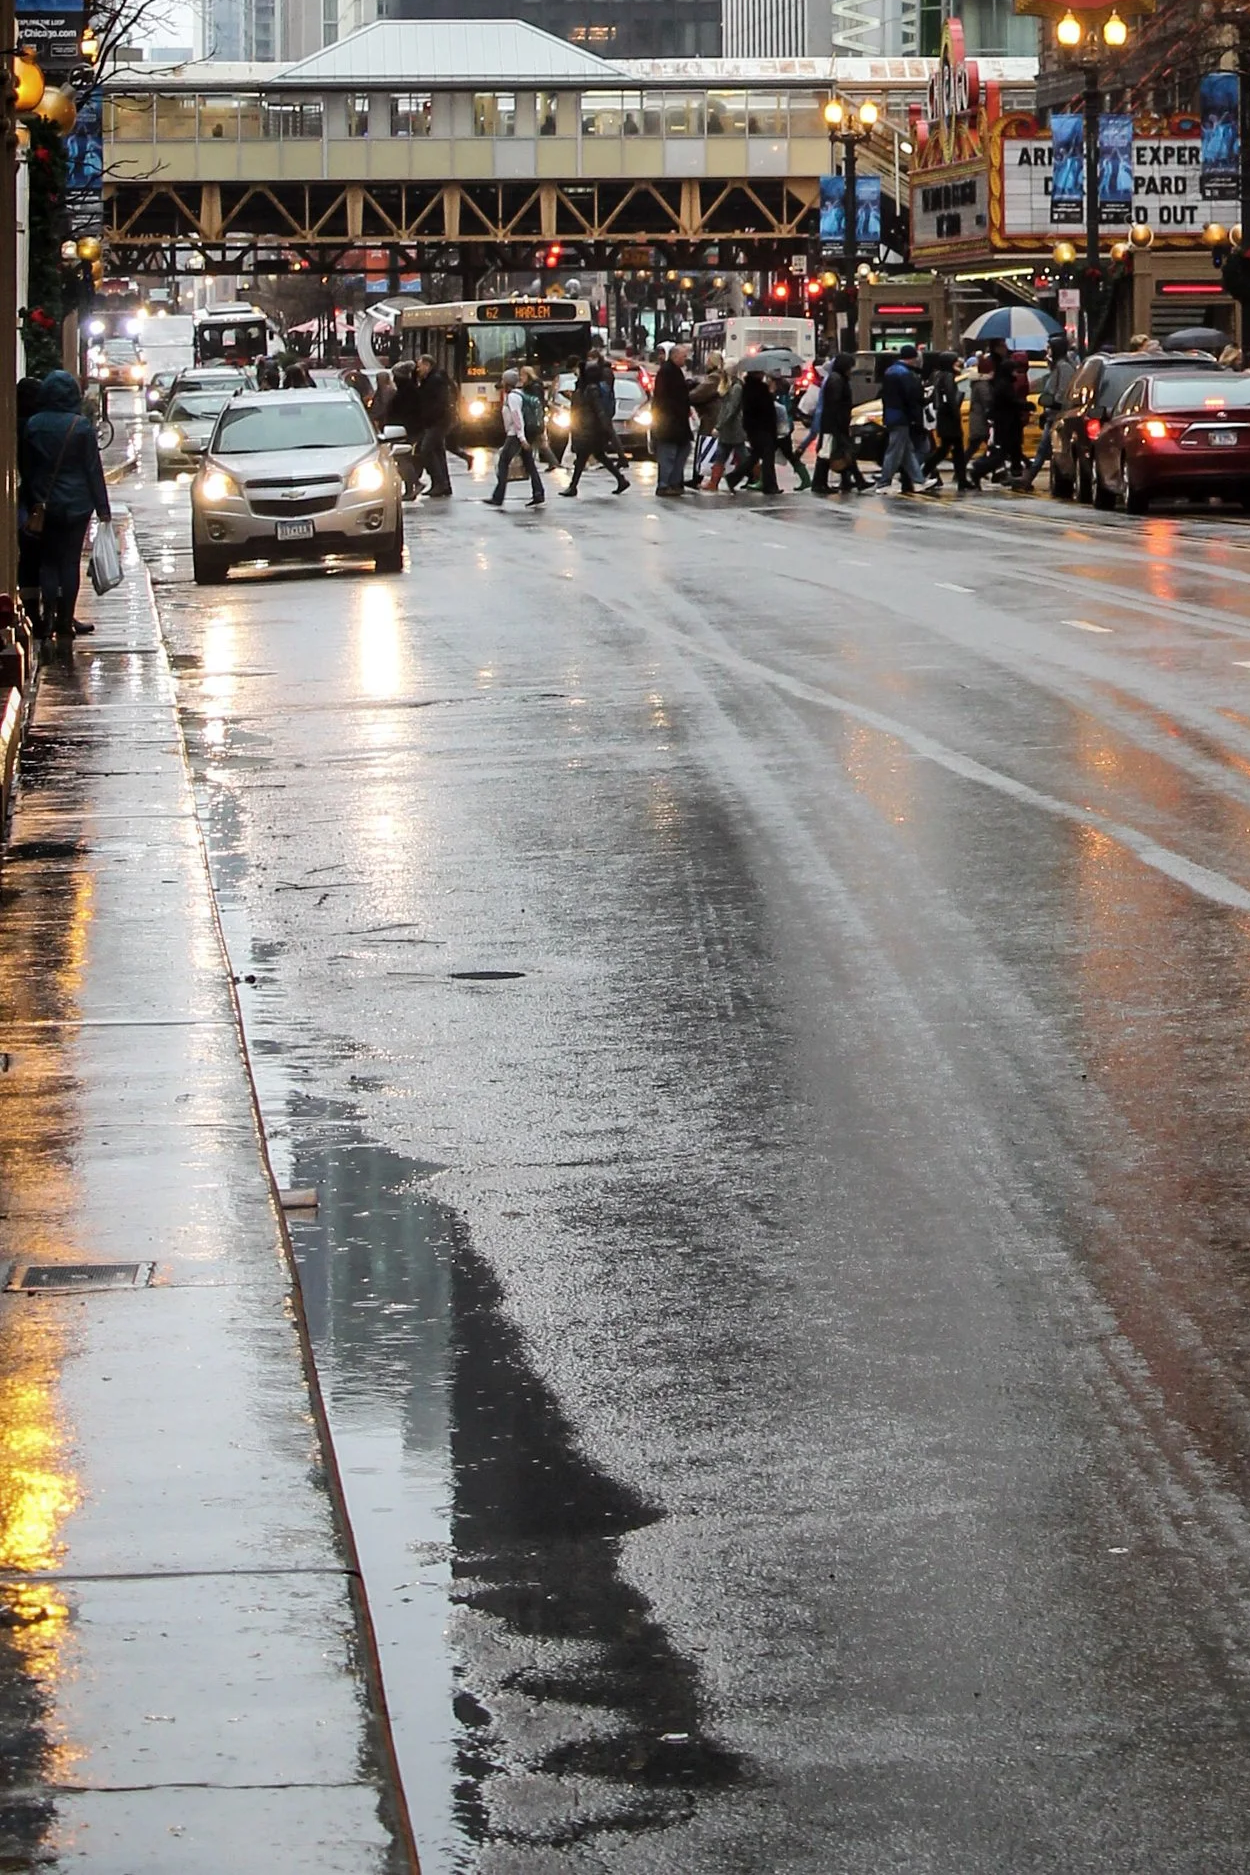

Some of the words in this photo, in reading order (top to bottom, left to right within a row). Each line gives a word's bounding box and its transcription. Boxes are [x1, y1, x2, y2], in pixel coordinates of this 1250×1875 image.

[1136, 146, 1200, 166] EXPER
[1134, 176, 1187, 195] PARD
[1159, 205, 1198, 224] OUT
[486, 307, 498, 318] 62
[515, 306, 551, 318] HARLEM
